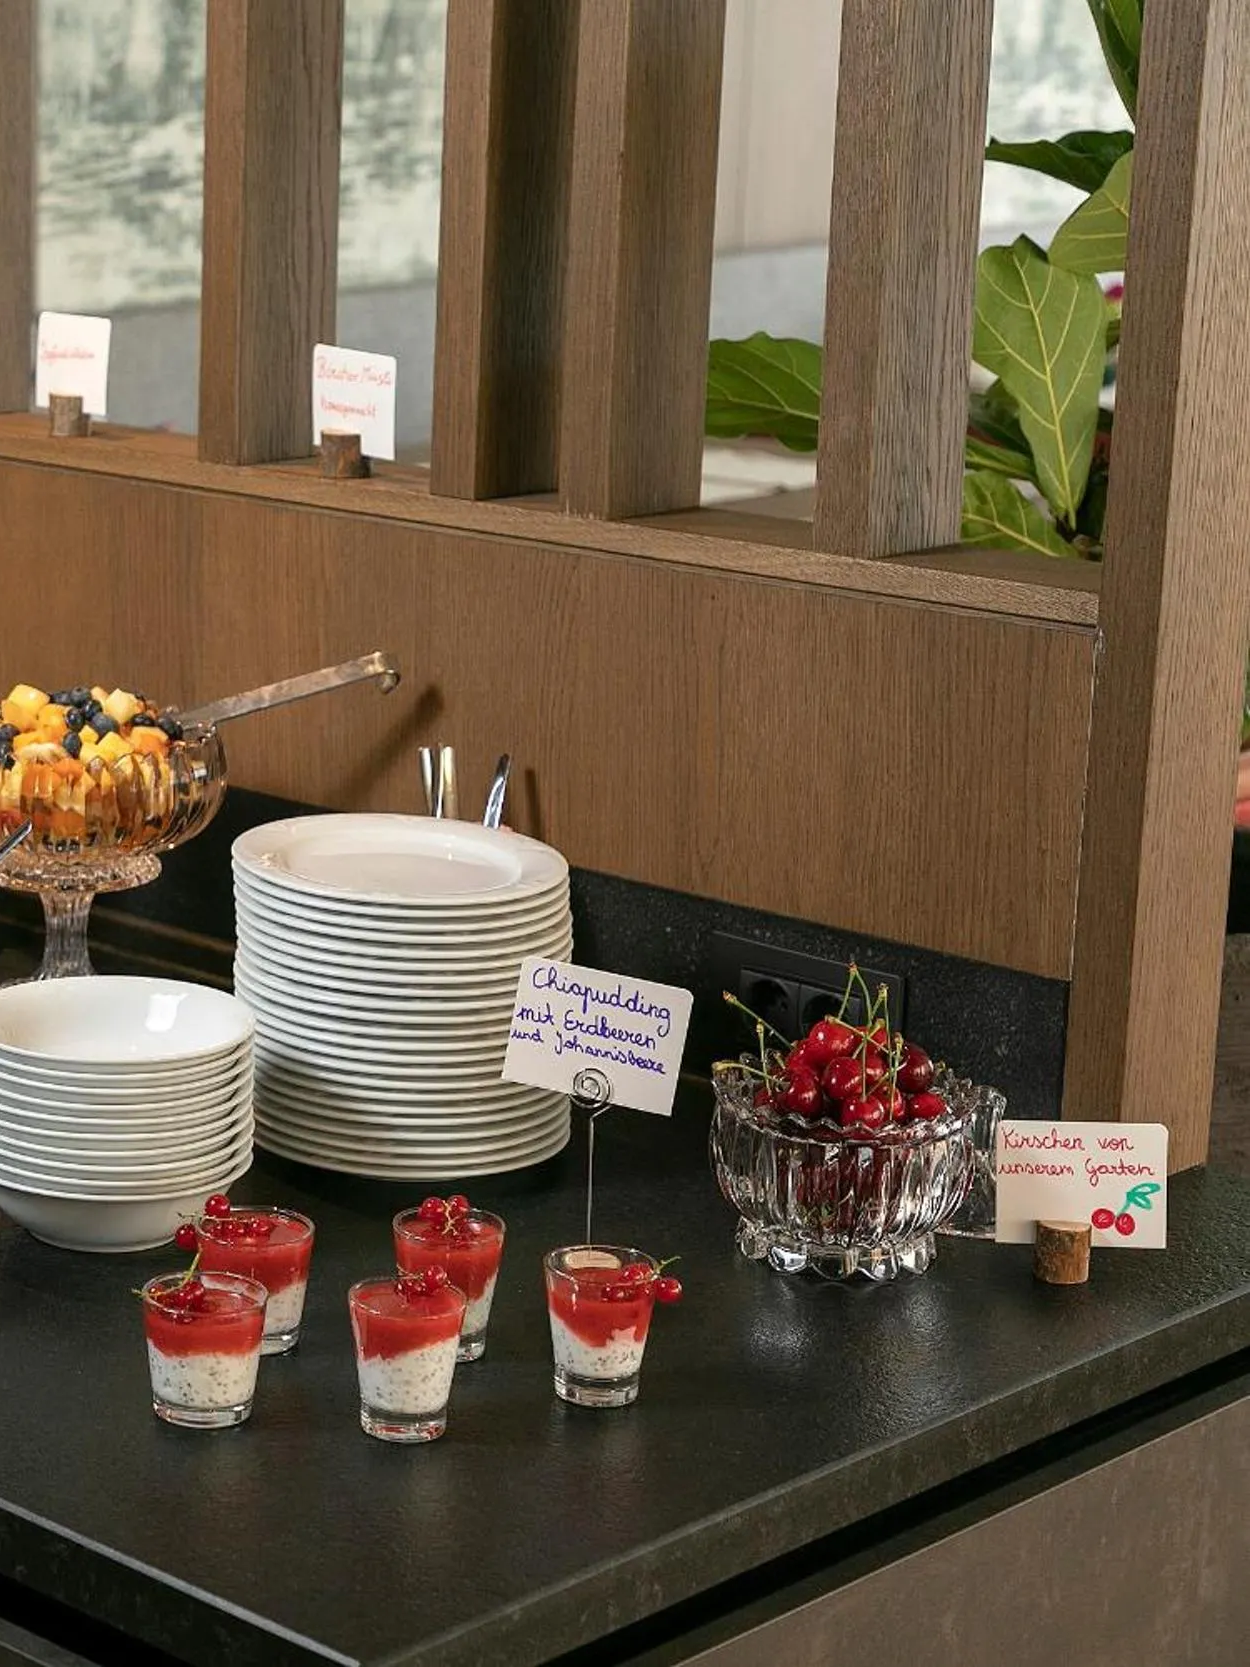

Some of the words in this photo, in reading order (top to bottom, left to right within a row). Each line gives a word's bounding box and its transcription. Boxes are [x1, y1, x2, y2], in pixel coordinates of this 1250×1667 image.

[532, 966, 671, 1038] Chiapudding
[510, 1027, 545, 1044] und
[516, 1002, 555, 1026] mit
[563, 1009, 657, 1051] Erdbeeren
[1001, 1126, 1087, 1152] Kirschen
[1097, 1137, 1136, 1151] von
[1084, 1157, 1156, 1188] Garten
